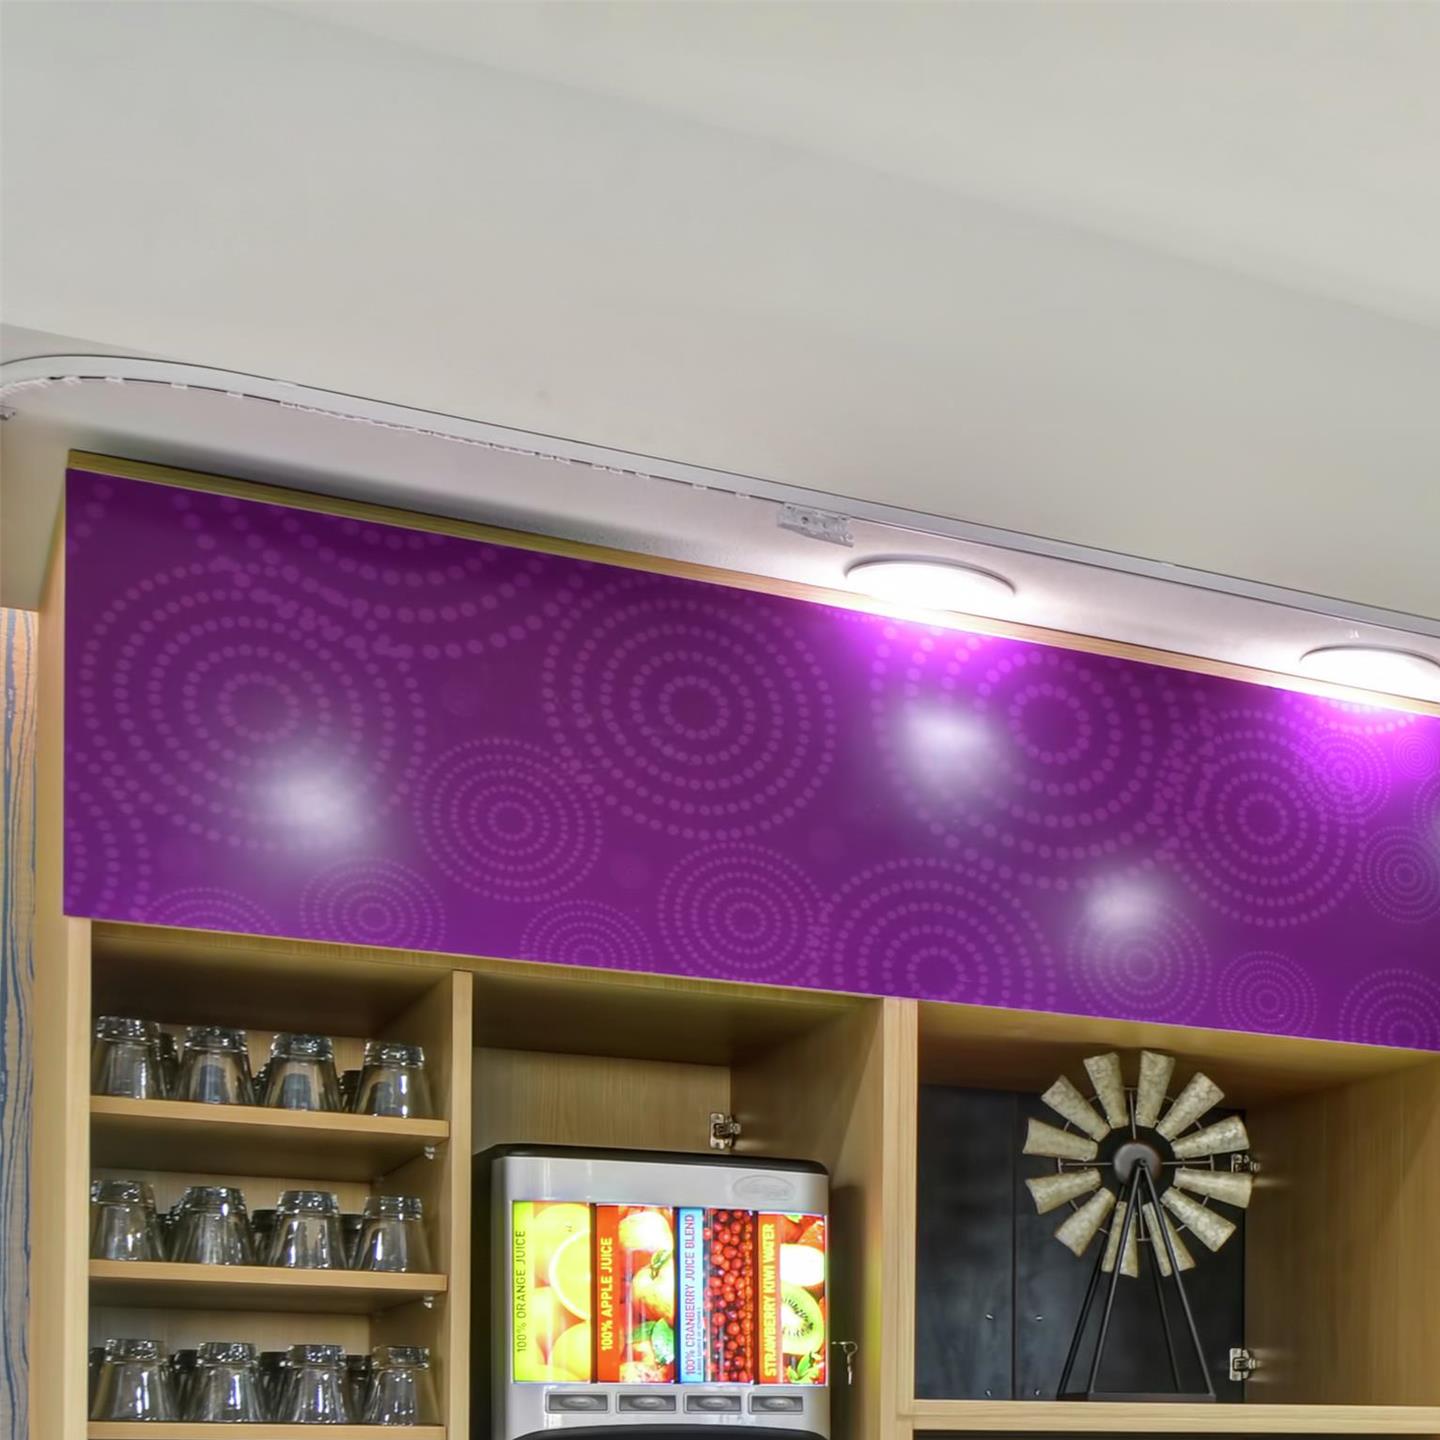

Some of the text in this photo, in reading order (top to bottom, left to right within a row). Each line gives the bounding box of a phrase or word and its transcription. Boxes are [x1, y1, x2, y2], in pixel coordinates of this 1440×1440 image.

[515, 1230, 527, 1353] 100% ORANGE JUICE
[600, 1237, 614, 1351] 100% APPLE JUICE
[684, 1214, 696, 1375] 100% CRANBERRY JUICE BLEND
[761, 1224, 777, 1377] STRAWBERRY KIWI WATER
